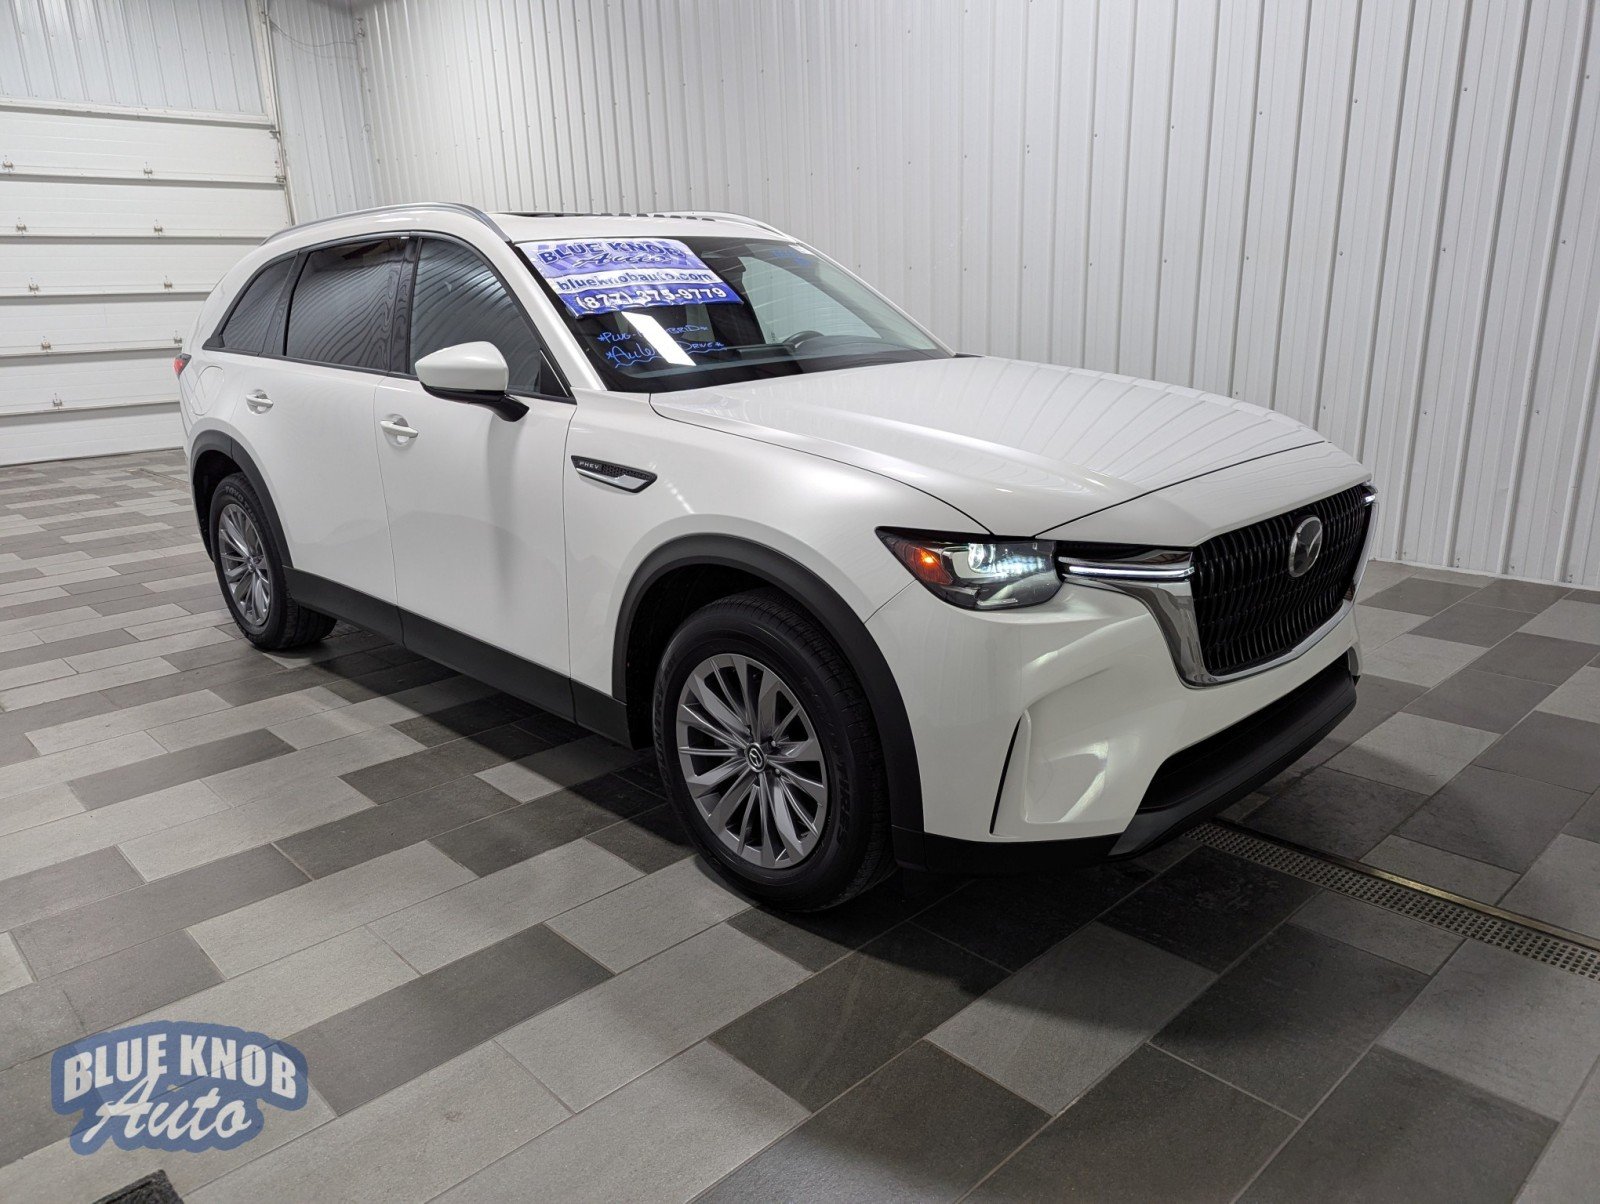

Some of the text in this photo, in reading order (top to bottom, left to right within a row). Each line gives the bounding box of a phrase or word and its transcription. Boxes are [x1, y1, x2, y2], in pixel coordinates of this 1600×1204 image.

[539, 241, 686, 264] BLUE KNOB
[572, 252, 671, 268] Auto
[636, 287, 727, 305] 375-9779
[579, 461, 600, 469] PHEV
